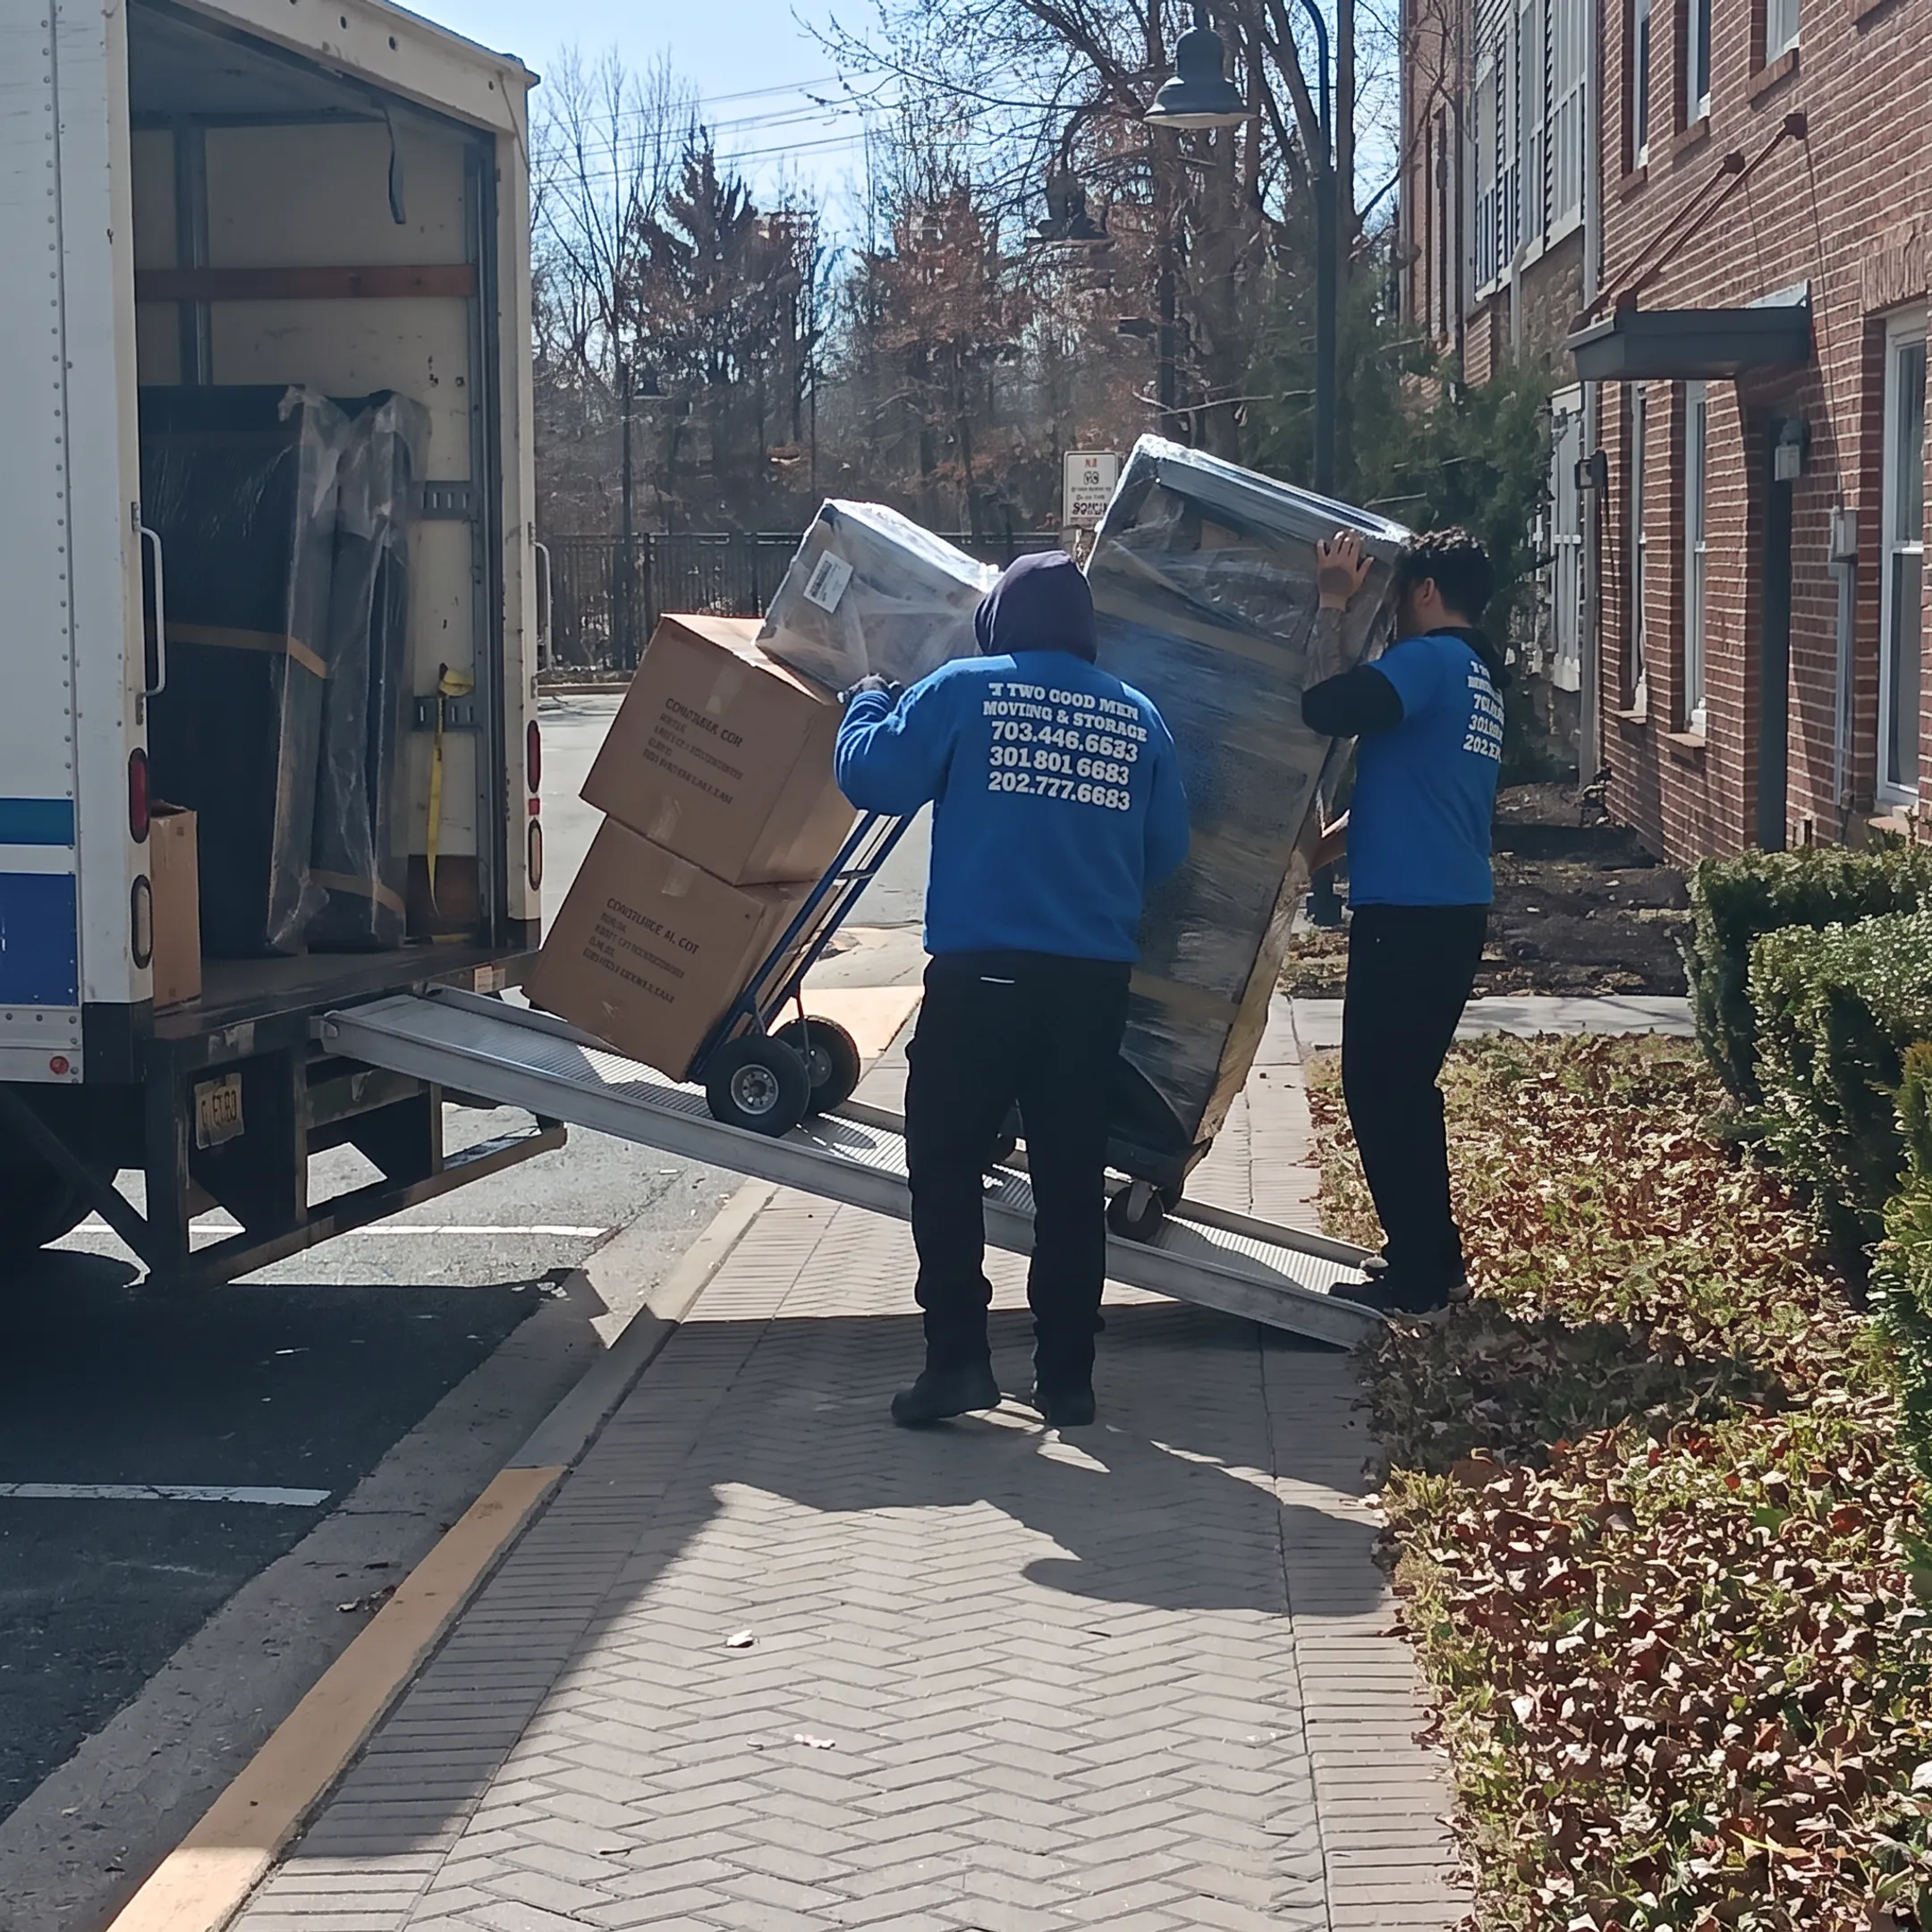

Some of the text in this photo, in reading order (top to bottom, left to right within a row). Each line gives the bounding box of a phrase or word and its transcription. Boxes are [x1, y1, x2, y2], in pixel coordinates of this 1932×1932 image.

[1007, 682, 1046, 700] TWO
[1049, 689, 1096, 708] GOOD
[1099, 699, 1139, 720] MEN
[983, 701, 1148, 742] MOVING & STORAGE
[987, 771, 1131, 810] 202.777.6683
